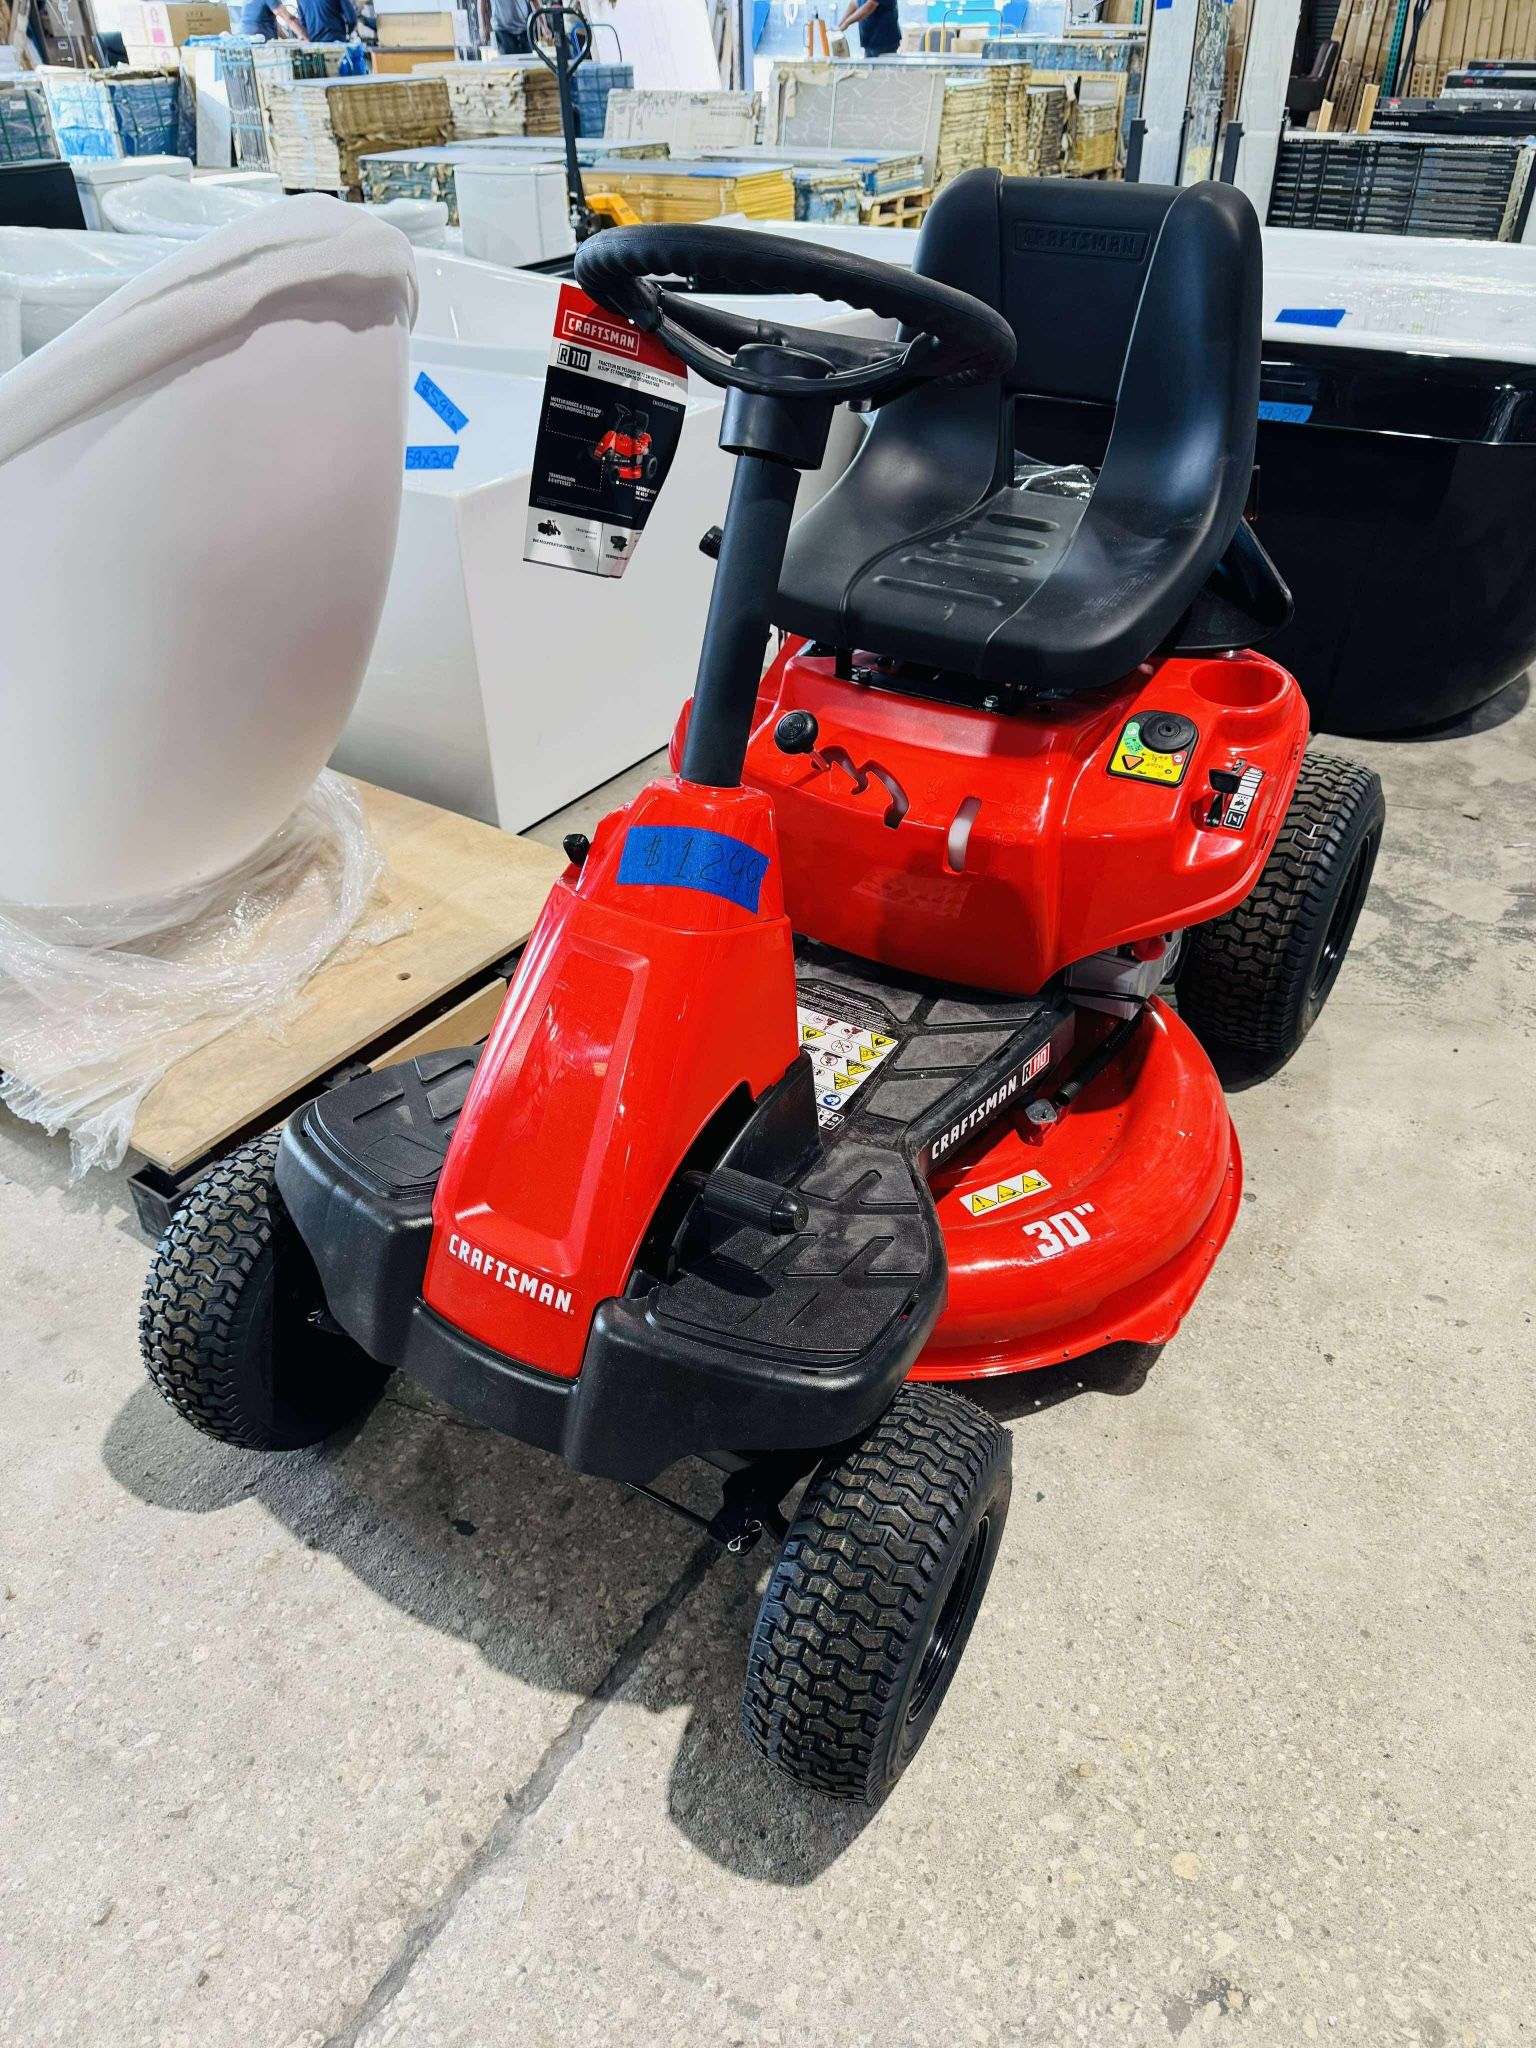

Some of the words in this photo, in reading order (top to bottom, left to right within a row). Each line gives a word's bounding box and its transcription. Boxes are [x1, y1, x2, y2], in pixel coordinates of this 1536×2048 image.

[568, 317, 635, 349] CRAFTSMAN
[931, 1075, 1018, 1160] CRAFTSMAN
[449, 1233, 574, 1314] CRAFTSMAN
